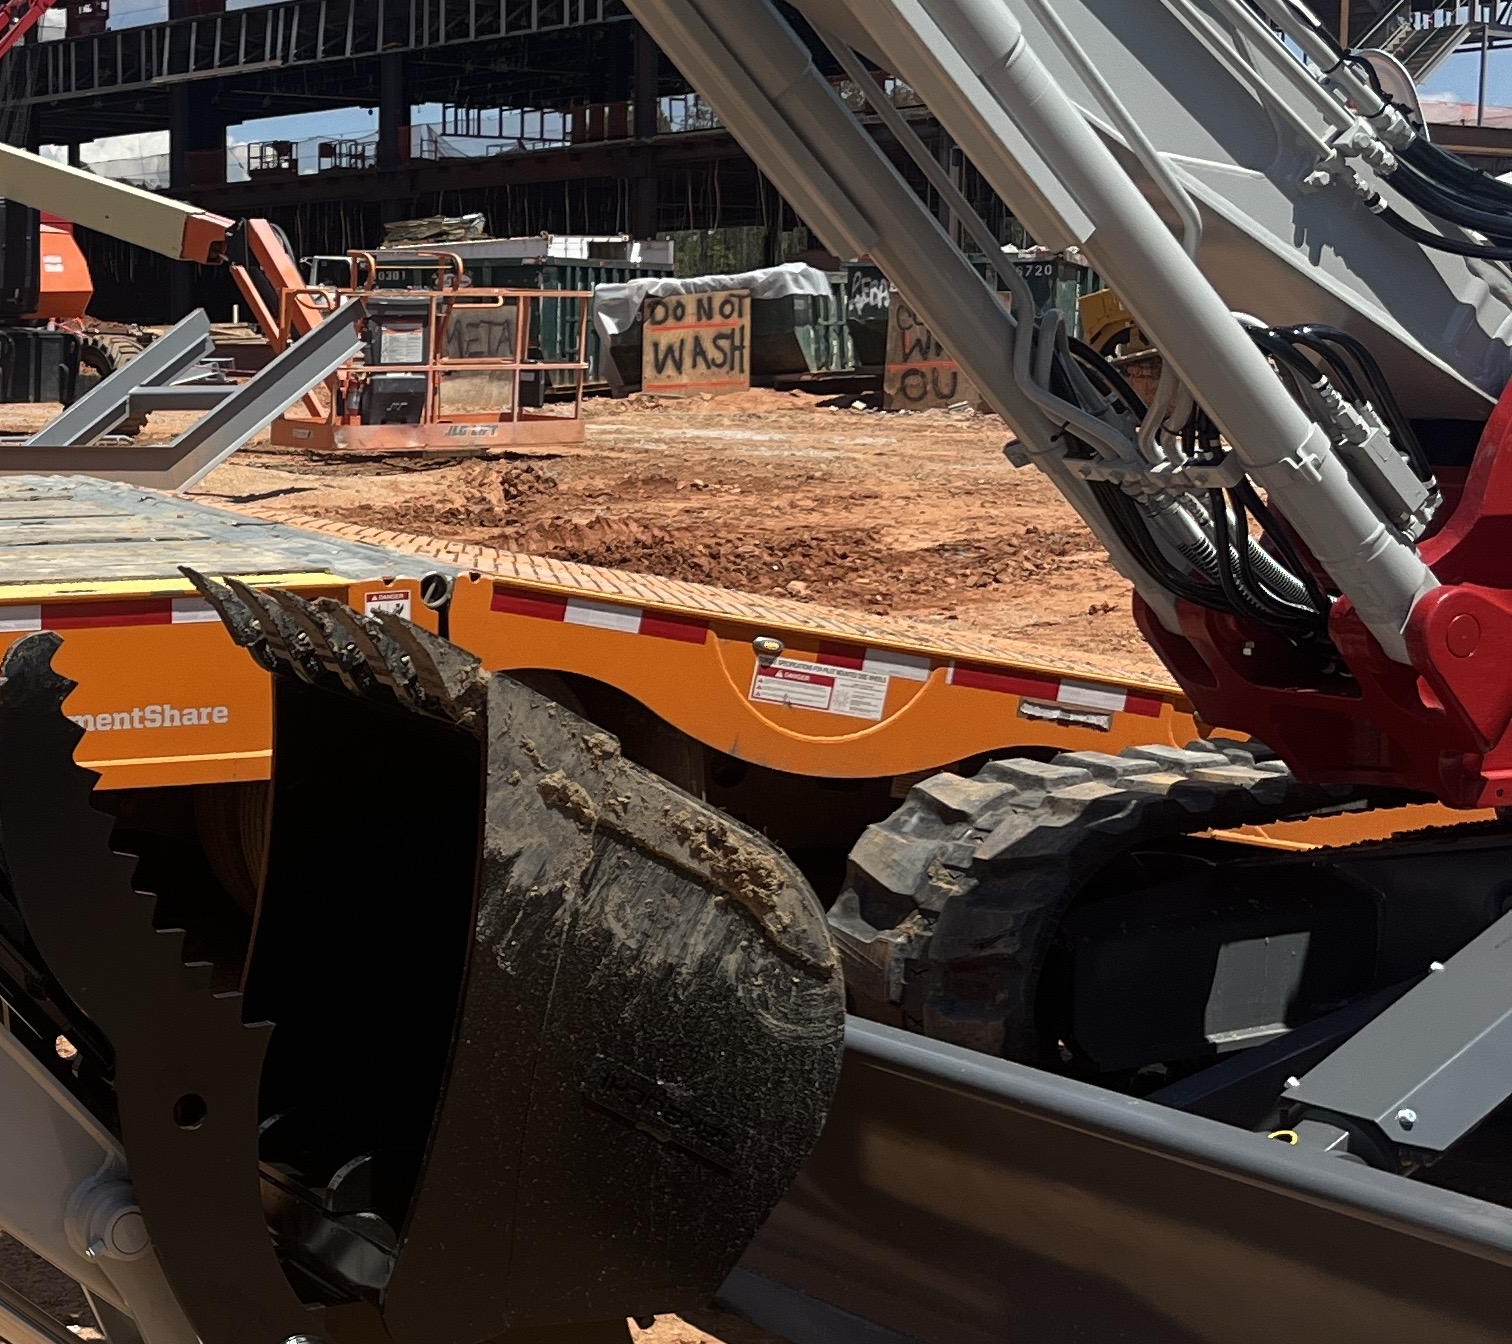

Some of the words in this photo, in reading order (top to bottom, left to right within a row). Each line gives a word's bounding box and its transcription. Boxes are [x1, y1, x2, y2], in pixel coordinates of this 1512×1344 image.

[649, 298, 686, 325] DO
[696, 293, 750, 322] NOT
[652, 324, 746, 375] WASH
